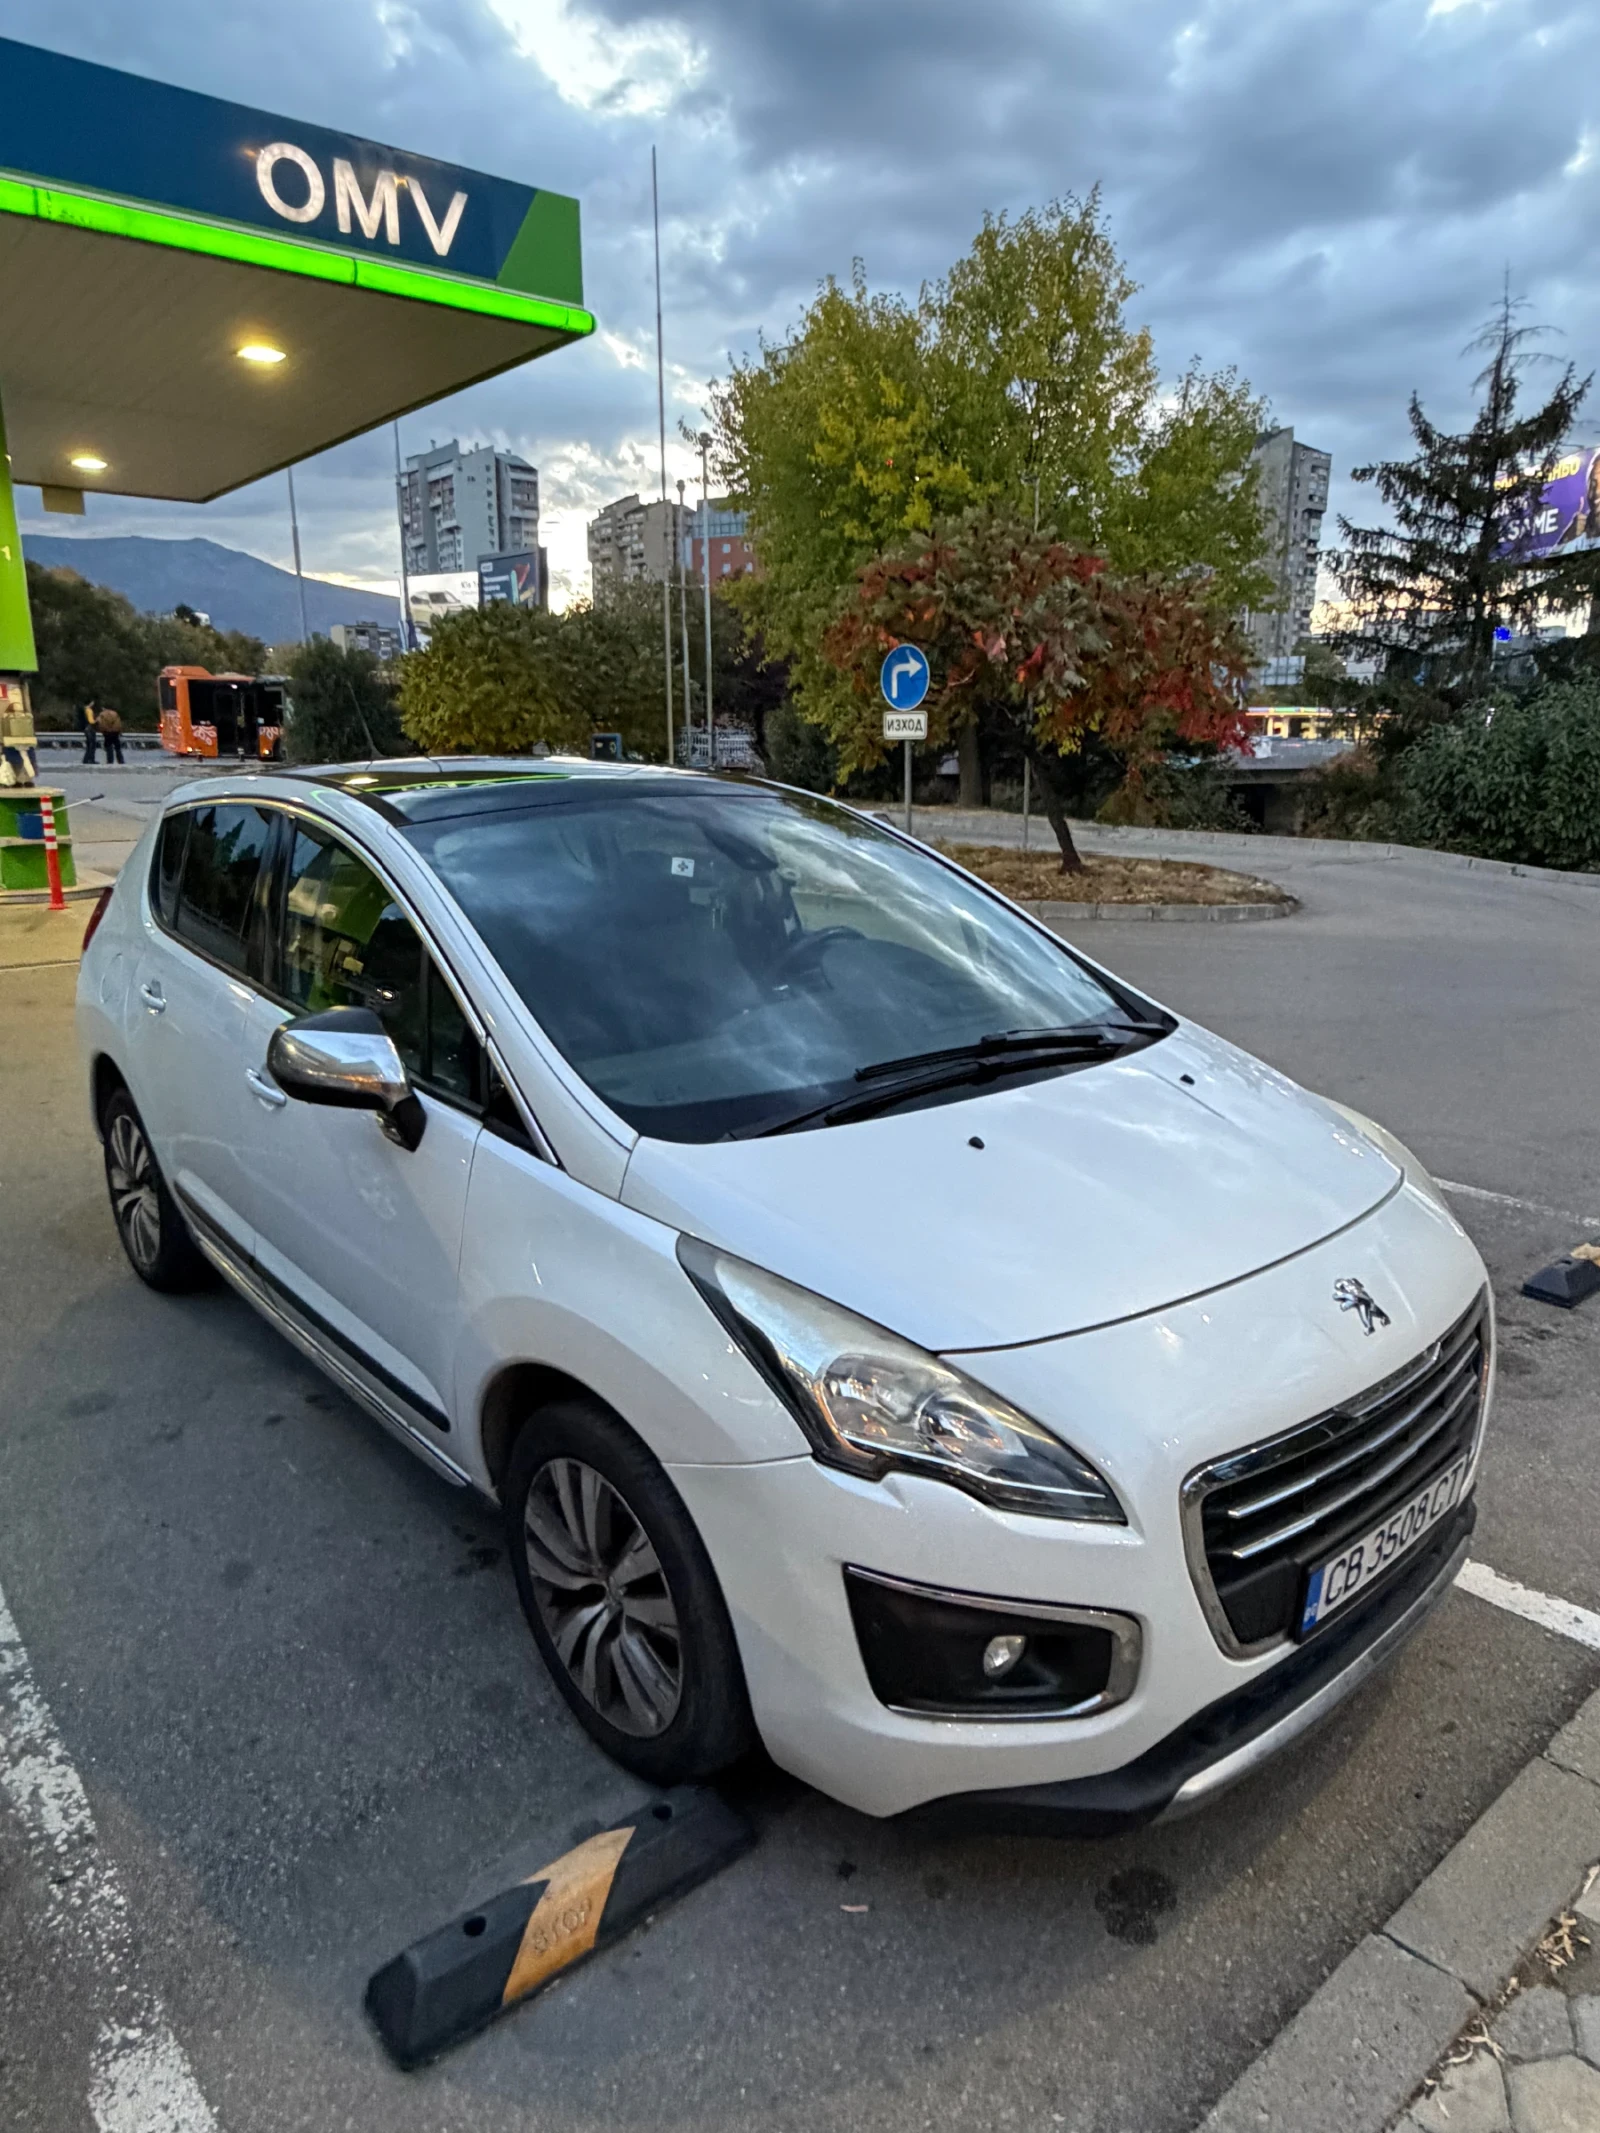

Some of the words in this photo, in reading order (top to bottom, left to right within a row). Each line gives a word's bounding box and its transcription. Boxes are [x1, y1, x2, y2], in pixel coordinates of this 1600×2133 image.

[256, 141, 468, 257] OMV
[887, 718, 924, 732] ИЗХОД
[1324, 1545, 1365, 1607] CB
[1366, 1492, 1430, 1575] 3508
[1429, 1461, 1465, 1520] CT
